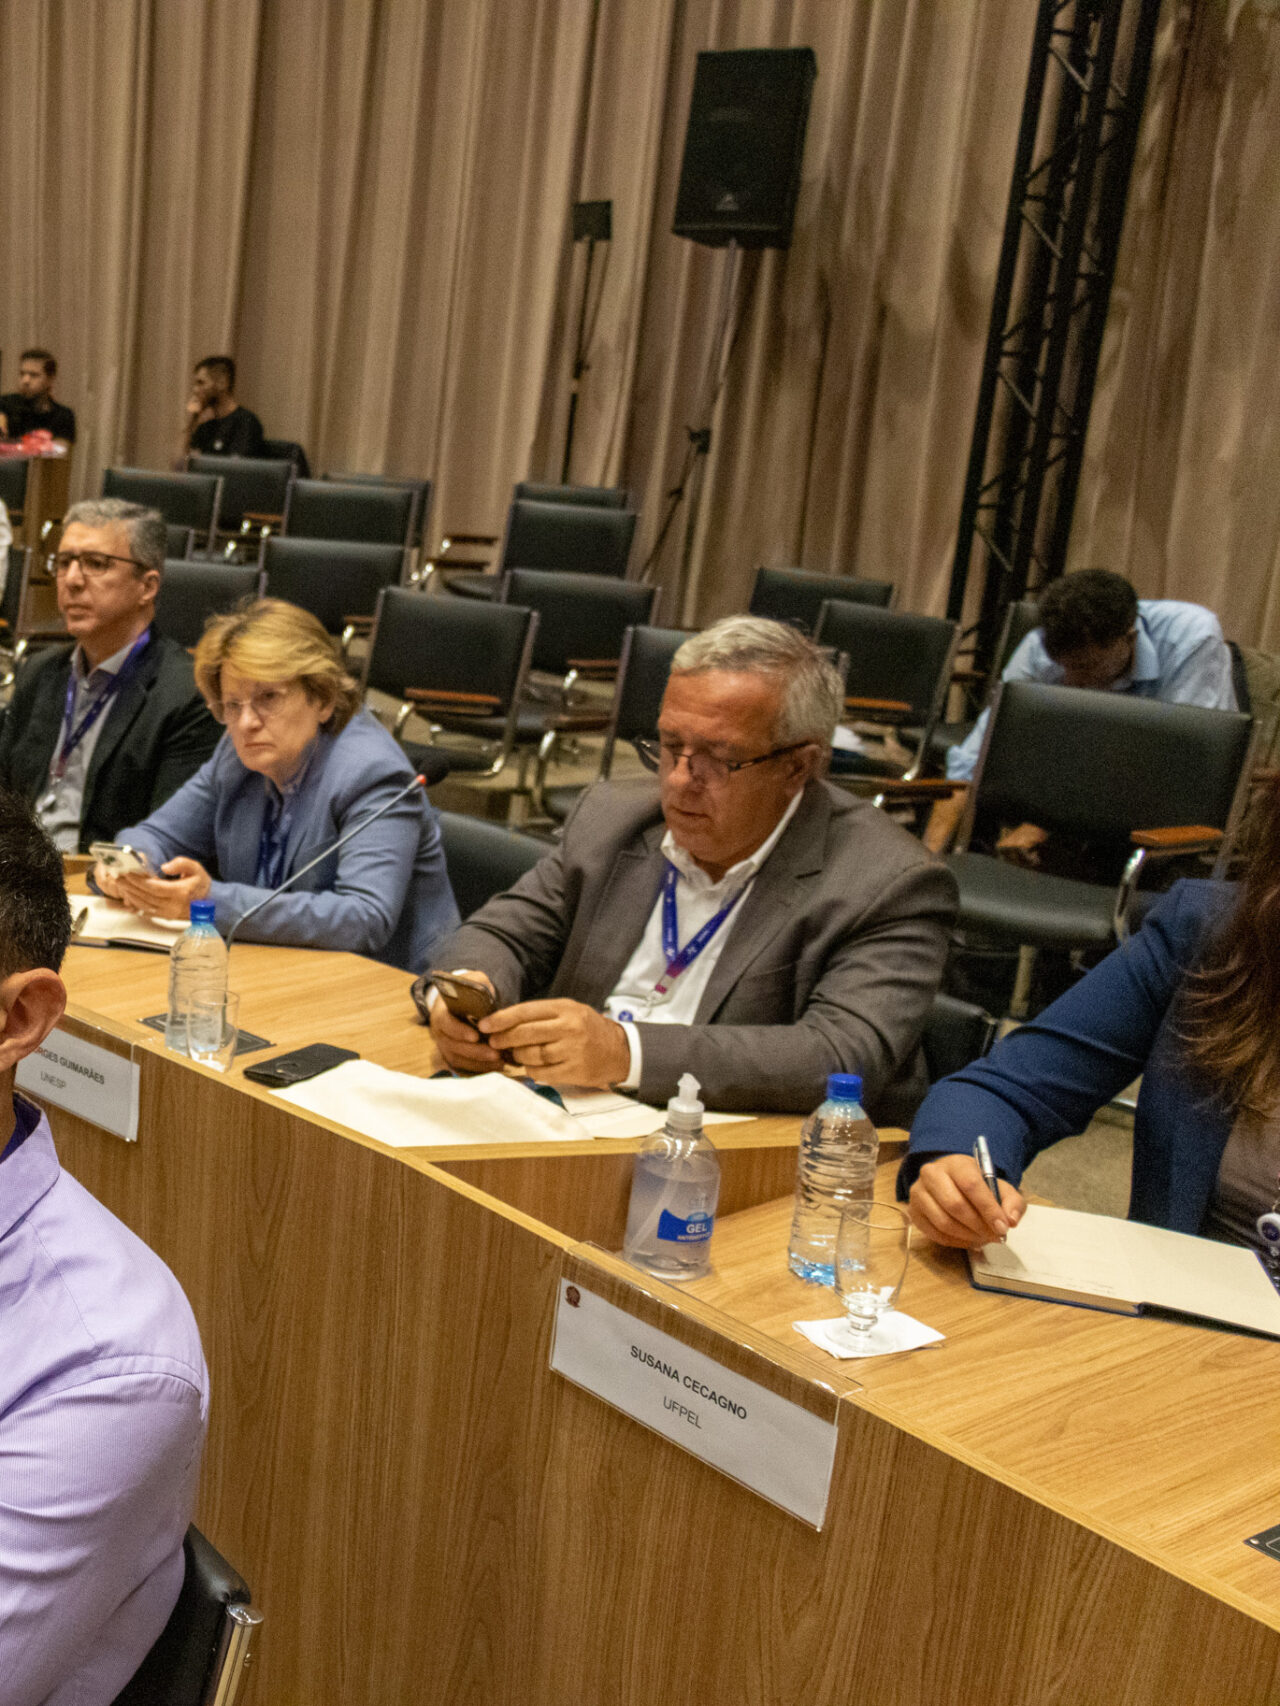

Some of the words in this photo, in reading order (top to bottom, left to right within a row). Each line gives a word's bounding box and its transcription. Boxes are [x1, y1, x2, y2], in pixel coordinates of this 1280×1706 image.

[40, 1071, 67, 1088] UNESP
[686, 1223, 708, 1234] GEL
[630, 1345, 680, 1384] SUSANA
[683, 1376, 747, 1420] CECAGNO
[662, 1396, 702, 1429] UFPEL
